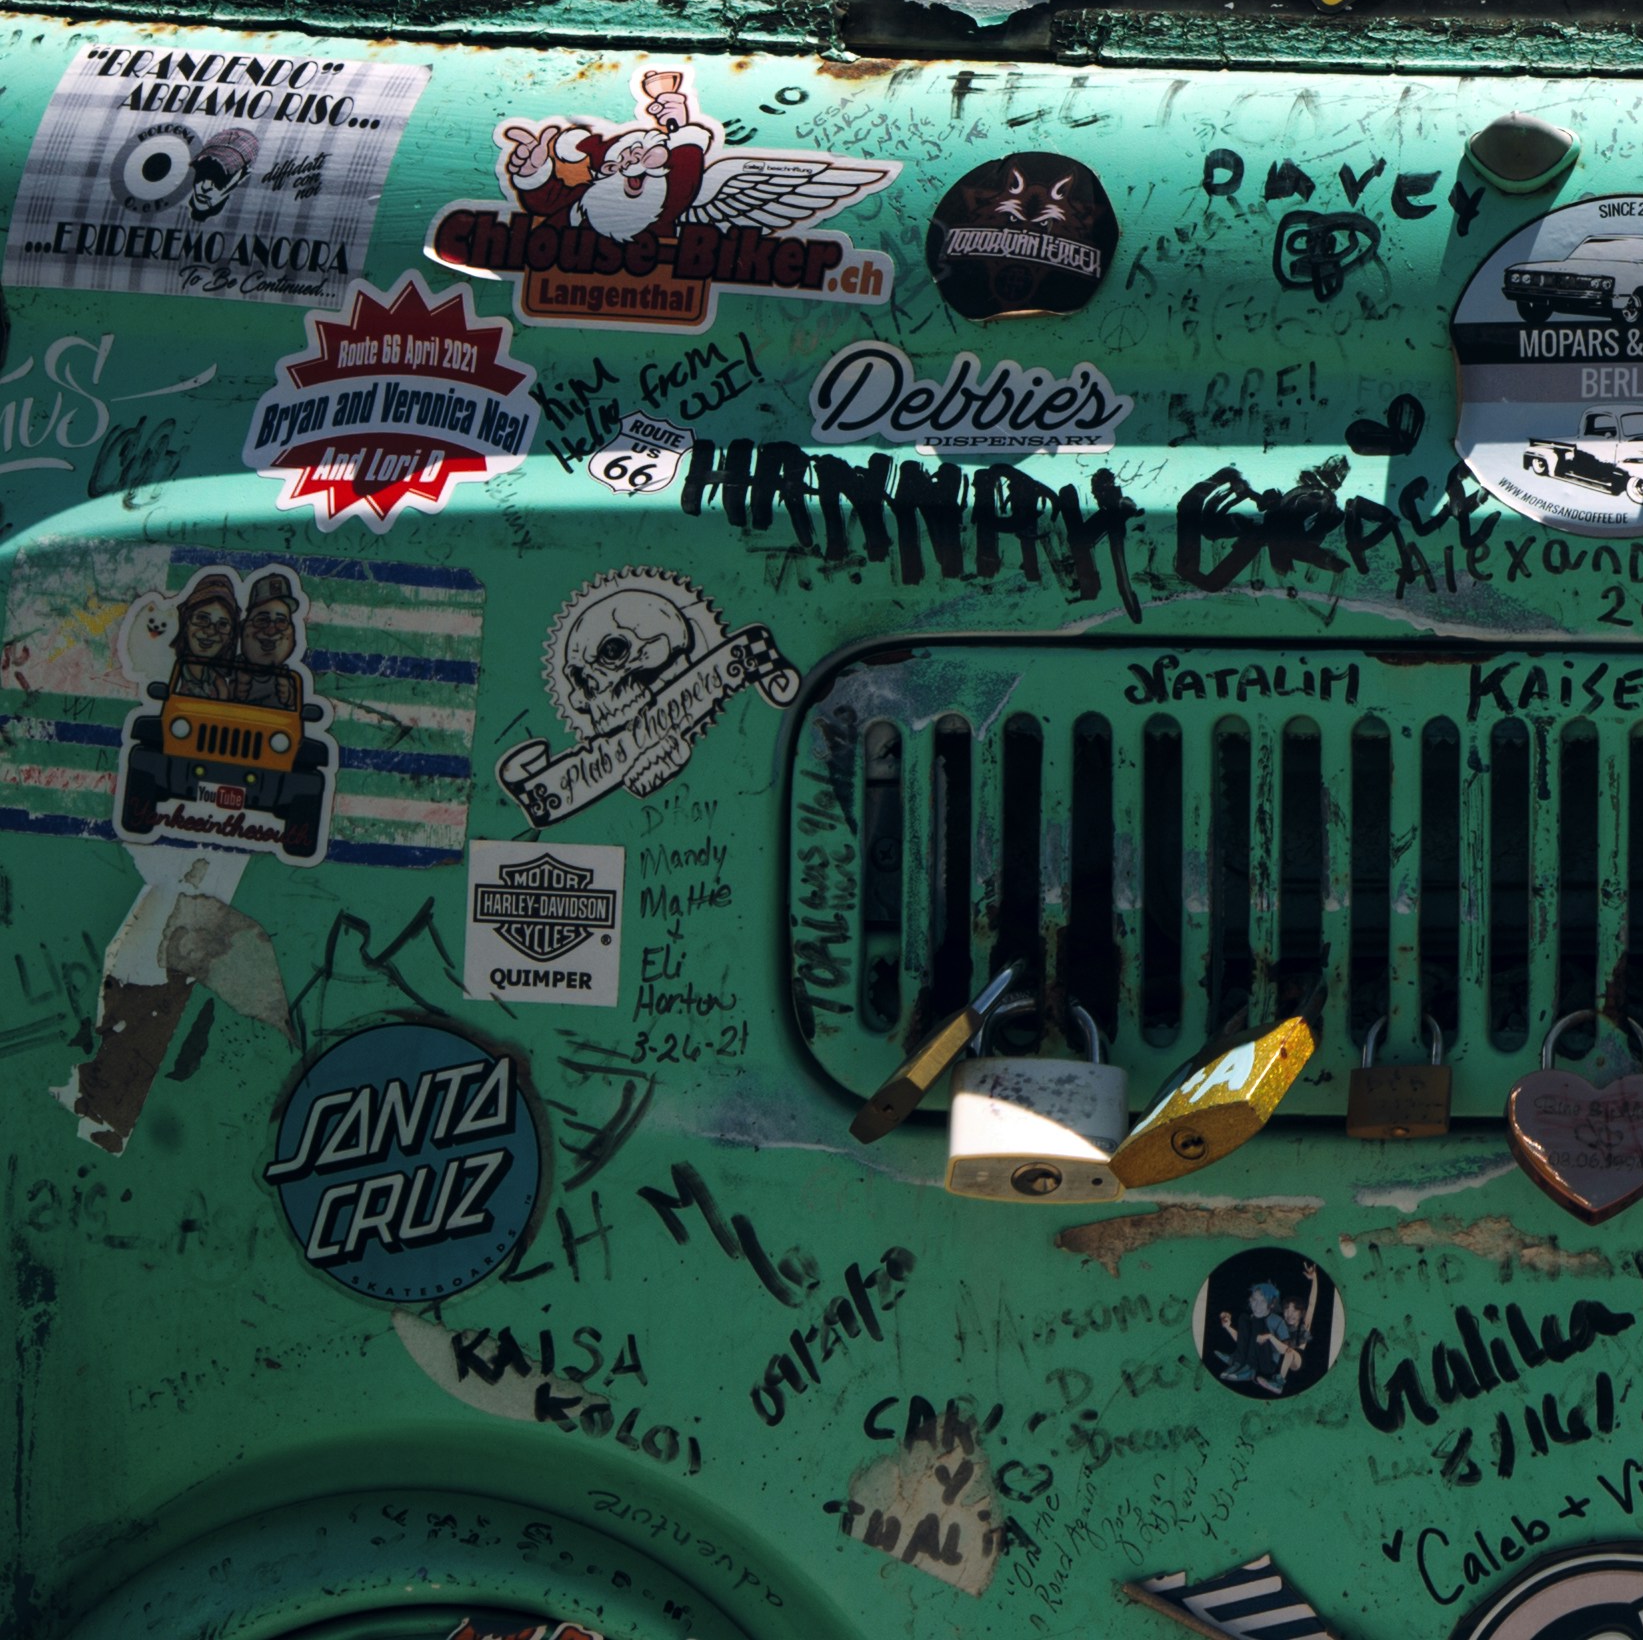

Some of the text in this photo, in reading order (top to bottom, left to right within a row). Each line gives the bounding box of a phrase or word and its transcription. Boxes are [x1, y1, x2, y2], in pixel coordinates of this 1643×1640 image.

[120, 88, 382, 130] ABBIAMO RISO...
[71, 227, 349, 275] RIDEREMO ANCORA
[538, 278, 695, 313] Langenthal
[339, 335, 479, 372] Route 66 April 2021
[1519, 329, 1619, 359] MOPARS
[819, 350, 1124, 433] Debbie's
[257, 380, 530, 454] Bryan and Veronica Neal
[924, 434, 1103, 448] DISPENSARY
[312, 447, 440, 483] And Lori D
[515, 872, 582, 889] MOTOR
[483, 892, 608, 918] HARLEY-DAVIDSON
[509, 926, 578, 950] CYCLES
[489, 967, 593, 992] QUIMPER
[266, 1057, 518, 1177] SANTA
[307, 1150, 513, 1260] CRUZ
